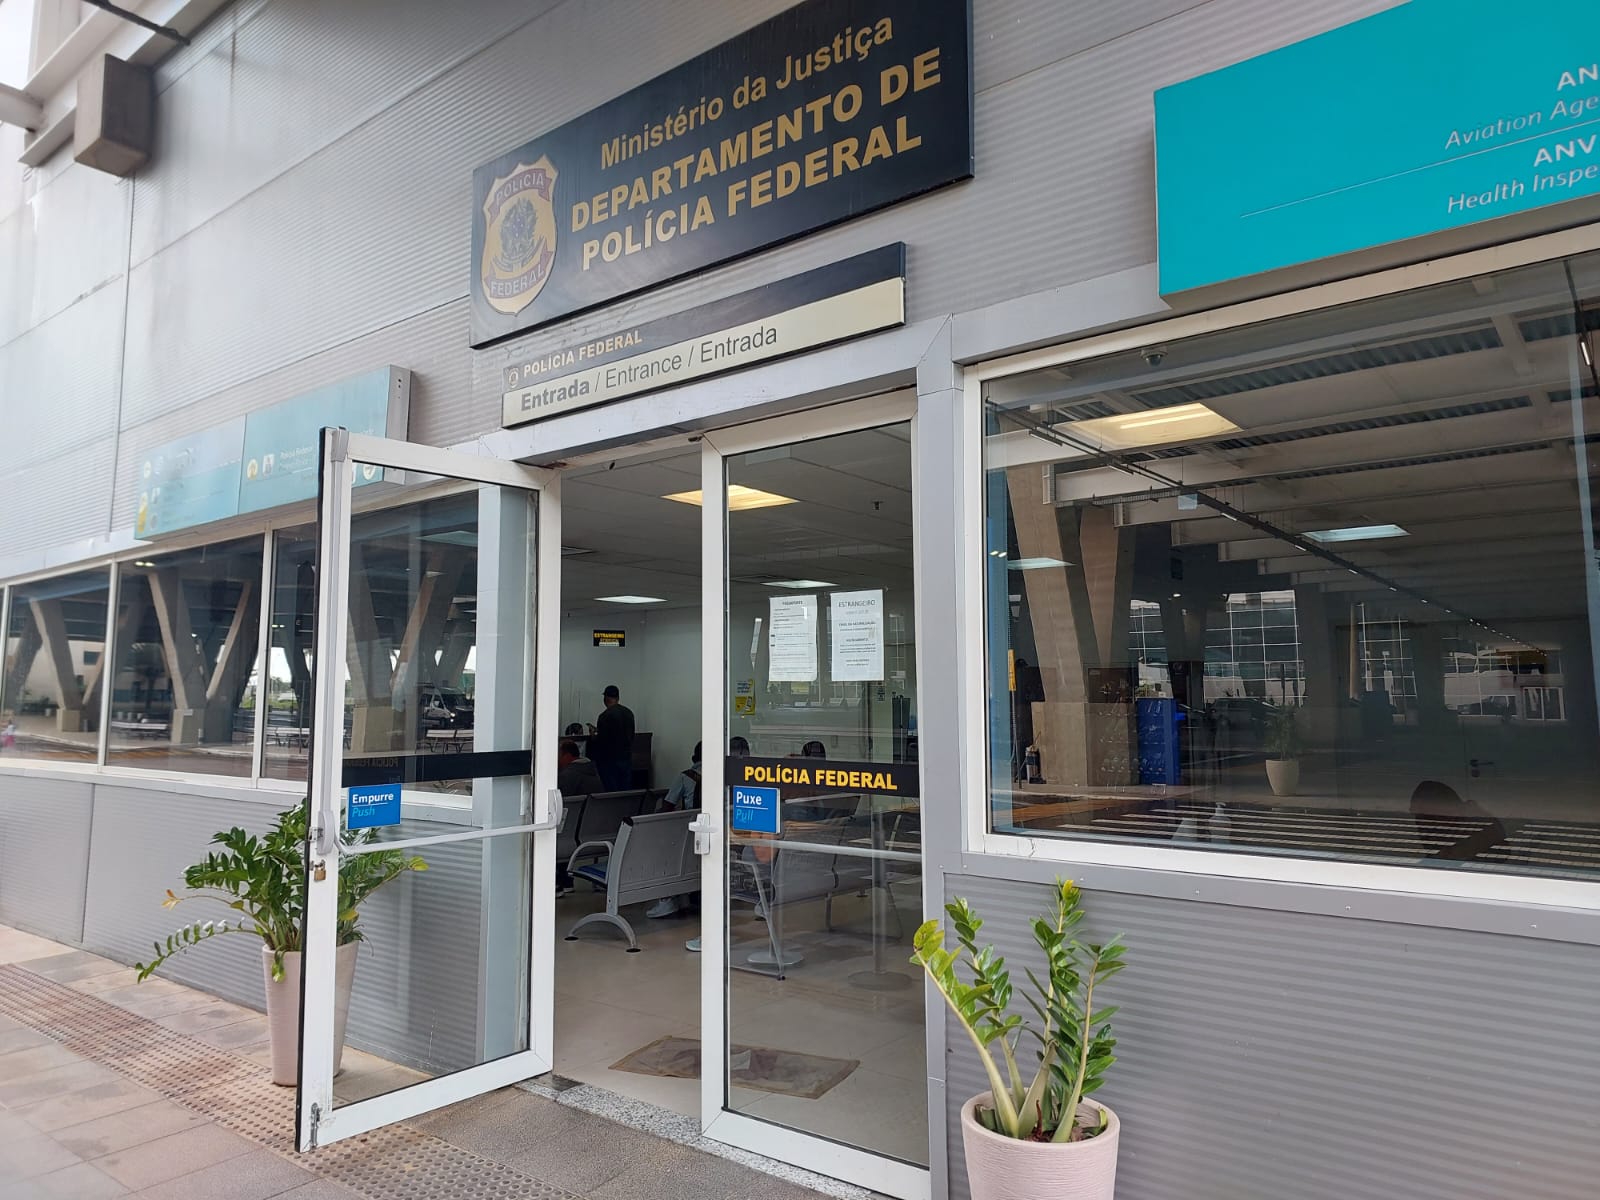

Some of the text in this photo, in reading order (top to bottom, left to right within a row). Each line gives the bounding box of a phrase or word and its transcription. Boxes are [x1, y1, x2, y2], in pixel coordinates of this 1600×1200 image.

[602, 17, 893, 170] Ministério da Justiça
[1557, 63, 1599, 91] AN
[1445, 96, 1600, 150] Aviation Age
[572, 47, 941, 233] DEPARTAMENTO DE
[1533, 134, 1597, 167] ANV
[583, 116, 922, 271] POLÍCIA FEDERAL
[1448, 164, 1600, 213] Health Inspe
[491, 267, 544, 296] FEDERAL
[521, 379, 590, 412] Entrada
[606, 353, 682, 389] Entrance
[700, 325, 777, 364] Entrada
[523, 329, 643, 377] POLÍCIA FEDERAL
[744, 764, 898, 791] POLÍCIA FEDERAL
[352, 792, 394, 805] Empurre
[352, 806, 376, 818] Push
[736, 791, 762, 806] Puxe
[736, 809, 754, 822] Pull
